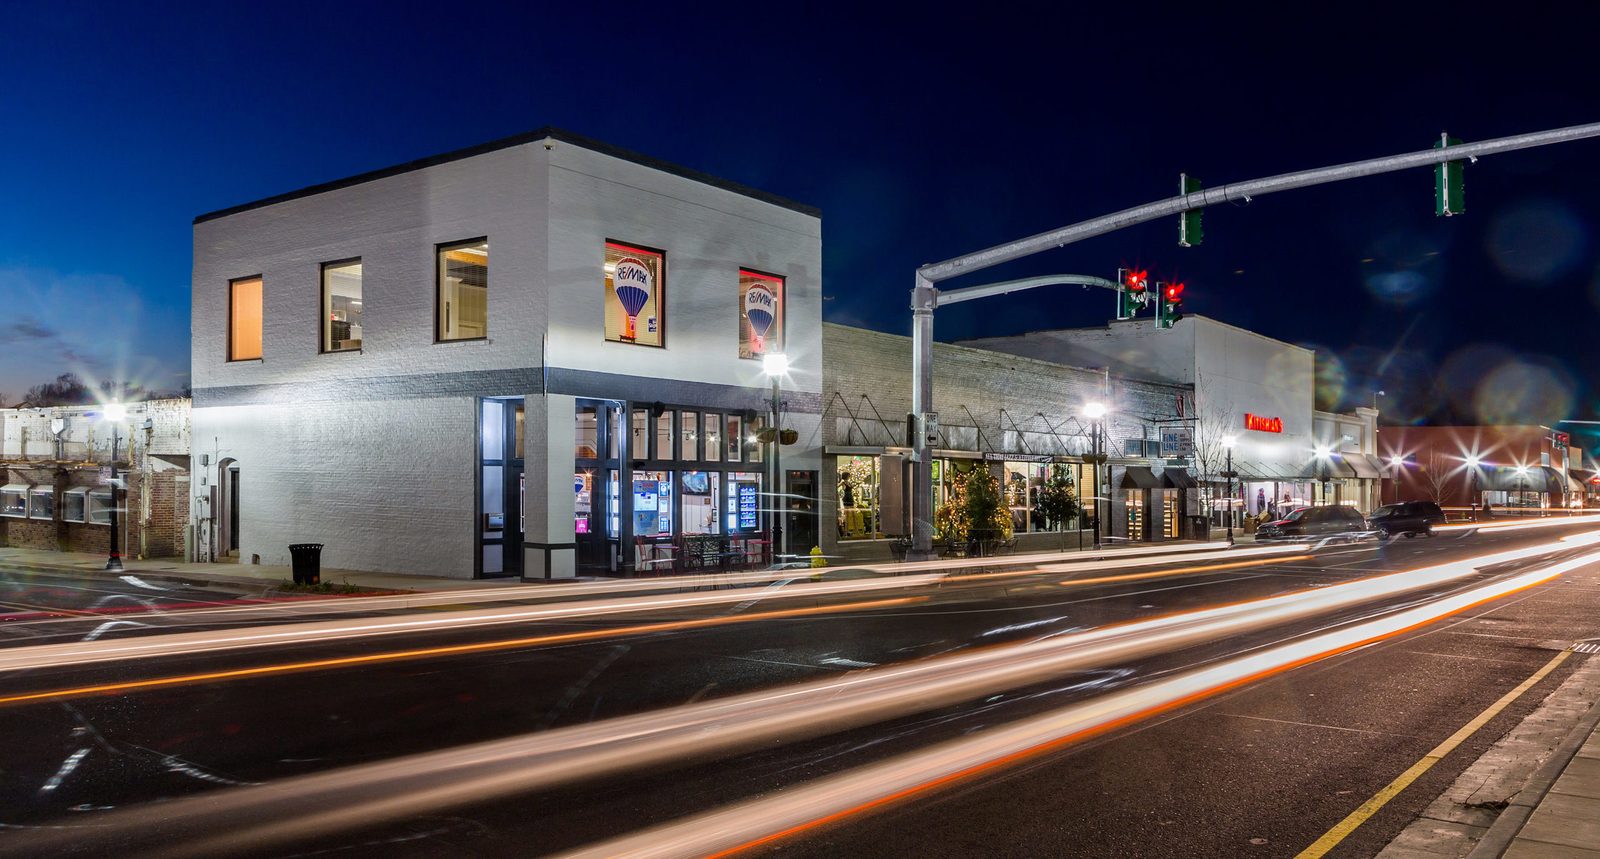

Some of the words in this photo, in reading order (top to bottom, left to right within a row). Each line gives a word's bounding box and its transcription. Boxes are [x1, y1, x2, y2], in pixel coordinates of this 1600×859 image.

[617, 265, 648, 285] RE/MAX
[749, 291, 772, 306] RE/MAX
[926, 414, 937, 423] ONE
[926, 424, 937, 432] WAY
[1163, 433, 1178, 442] FINE
[1163, 442, 1178, 451] LINE
